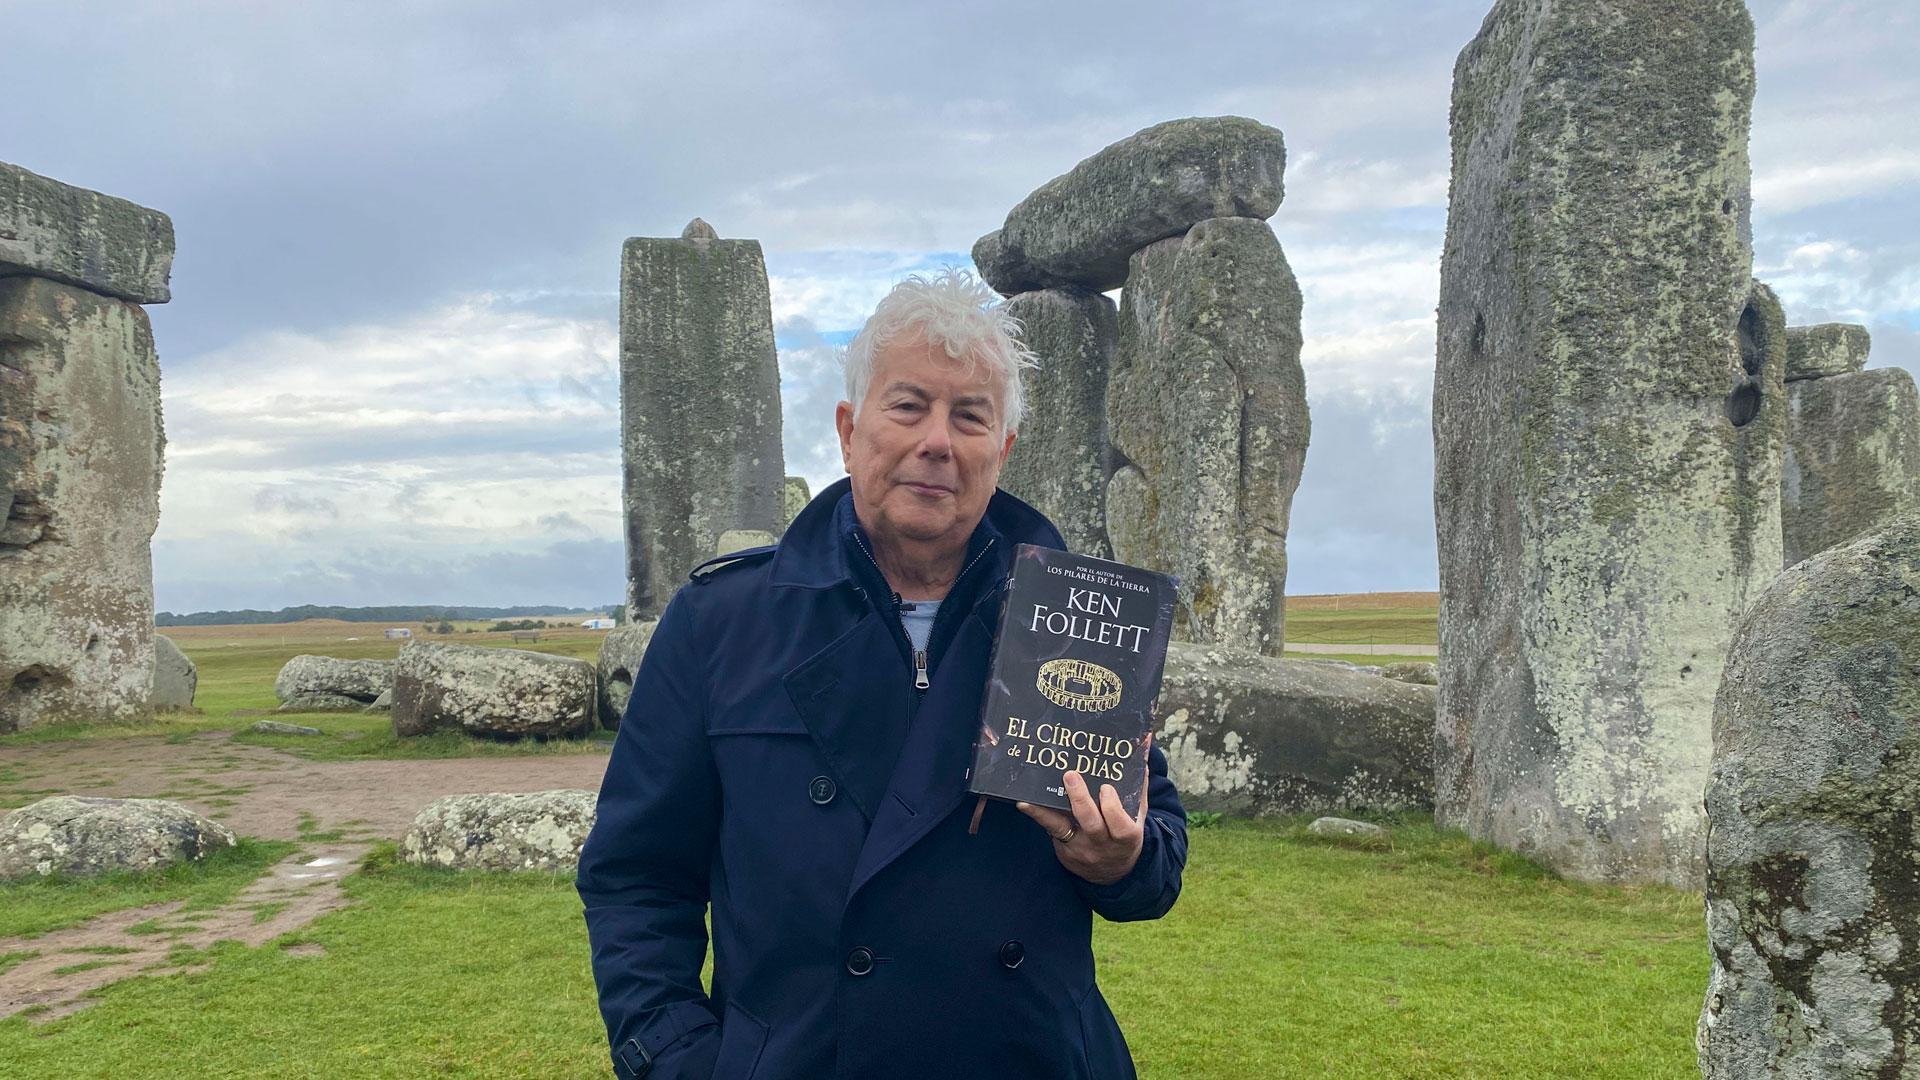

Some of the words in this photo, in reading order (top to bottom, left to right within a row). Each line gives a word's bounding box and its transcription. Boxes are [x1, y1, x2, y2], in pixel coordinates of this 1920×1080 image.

[1047, 565, 1062, 575] LOS
[1064, 569, 1095, 582] PILARES
[1097, 576, 1108, 584] DE
[1109, 579, 1120, 588] LA
[1121, 581, 1150, 594] TIERRA
[1096, 570, 1115, 578] AUTOR
[1066, 587, 1123, 618] KEN
[1029, 604, 1150, 653] FOLLETT
[1006, 717, 1030, 740] EL
[1036, 723, 1133, 759] CÍRCULO
[1007, 744, 1021, 757] de
[1025, 744, 1069, 771] LOS
[1076, 754, 1124, 781] DÍAS
